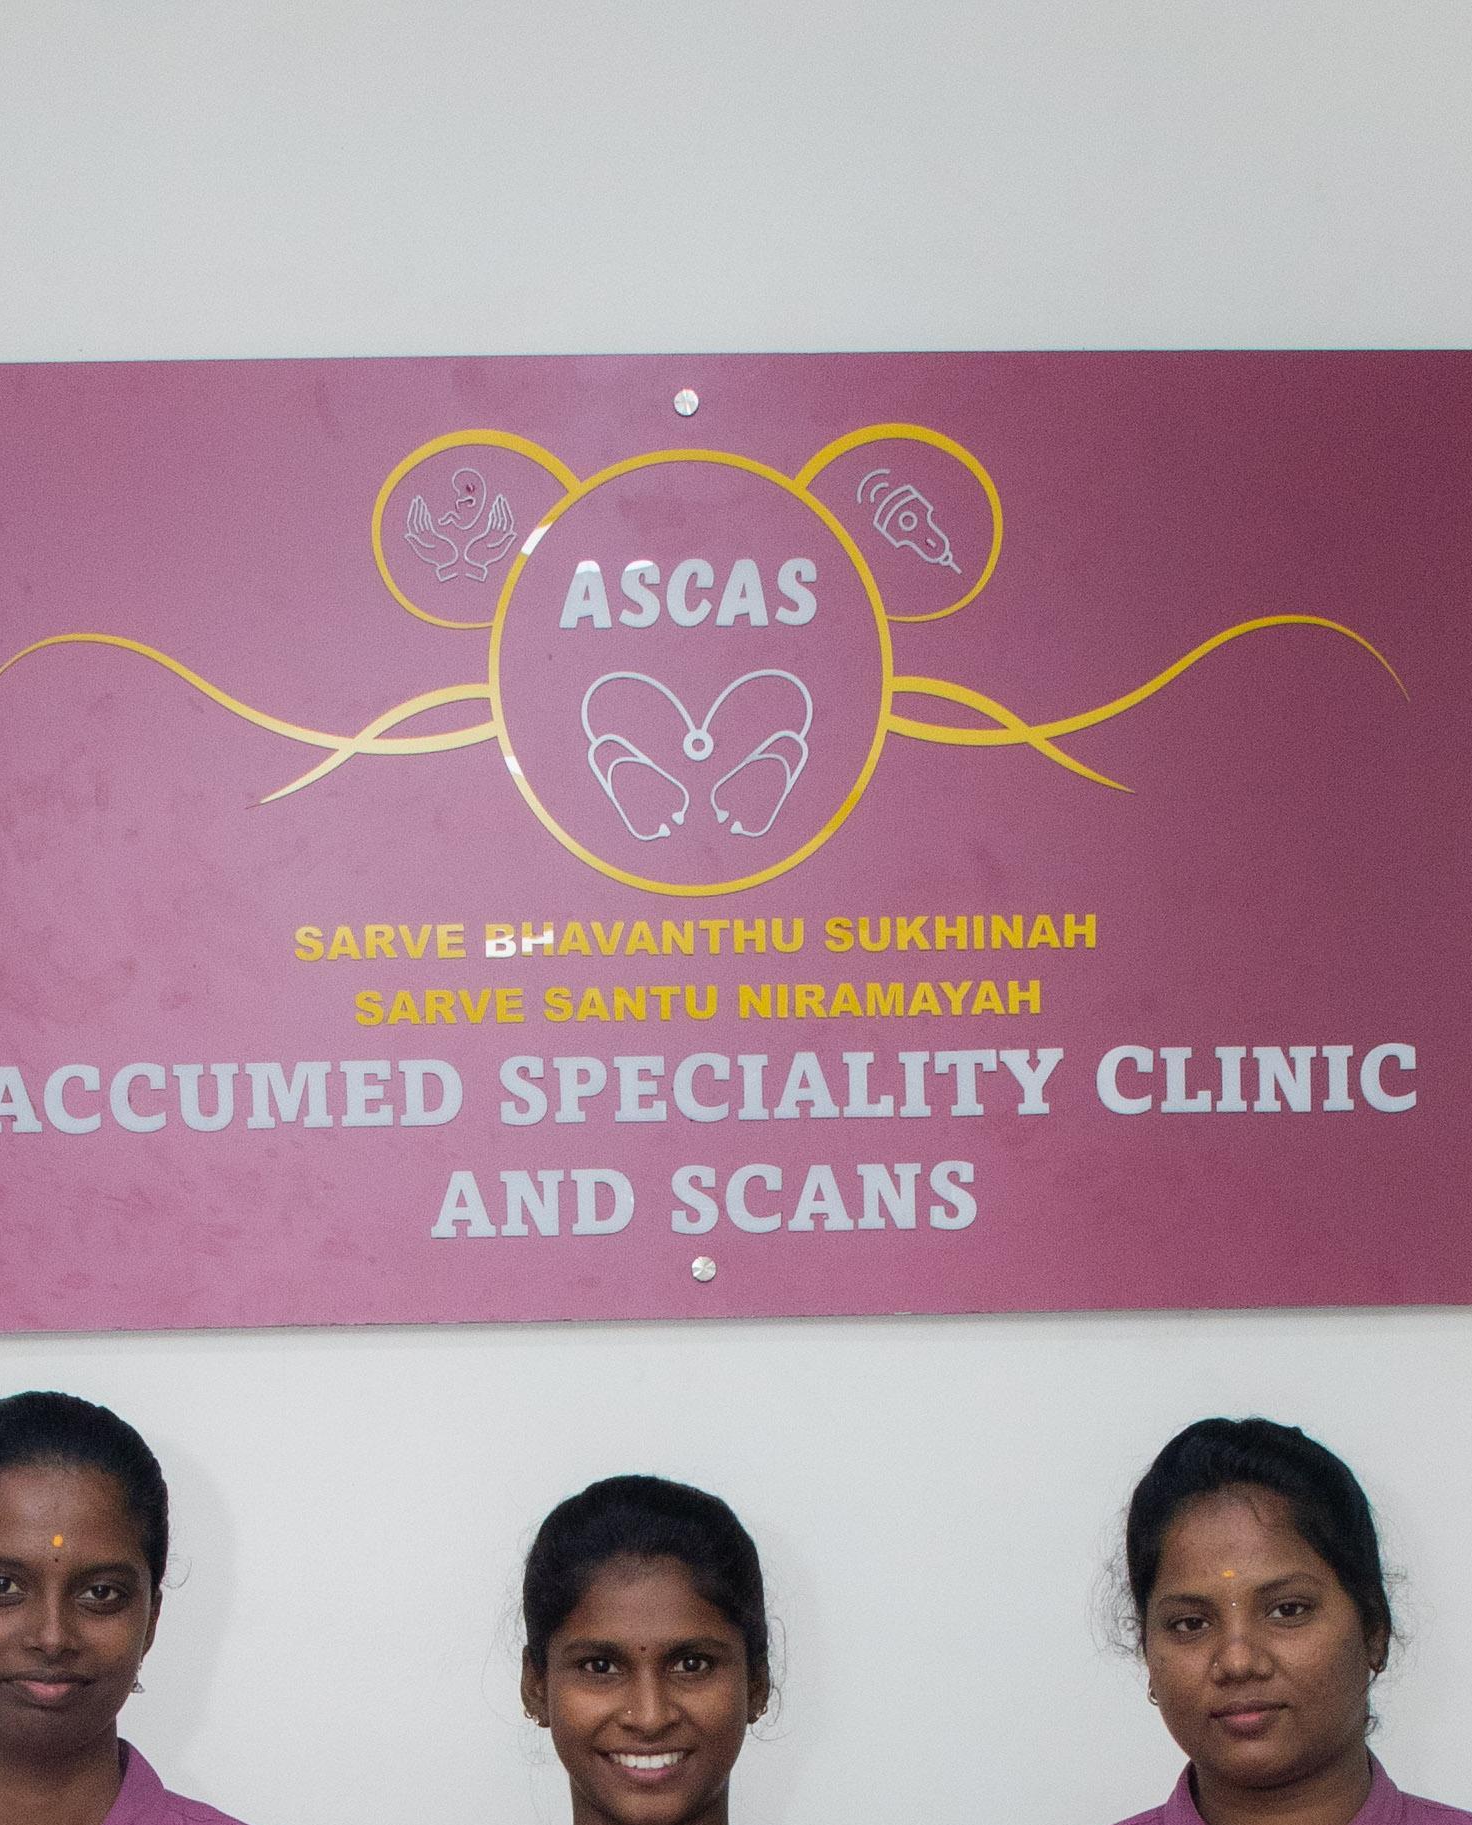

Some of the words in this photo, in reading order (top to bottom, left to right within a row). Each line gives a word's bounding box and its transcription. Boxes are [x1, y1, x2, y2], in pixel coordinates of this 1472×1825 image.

[558, 557, 818, 630] ASCAS
[295, 924, 467, 962] SARVE
[485, 918, 806, 959] BHAVANTHU
[824, 913, 1098, 953] SUKHINAH
[354, 988, 524, 1028] SARVE
[544, 983, 718, 1023] SANTU
[739, 978, 1043, 1019] NIRAMAYAH
[499, 1048, 1064, 1126] SPECIALITY
[1096, 1042, 1417, 1115] CLINIC
[429, 1168, 636, 1239] AND
[671, 1160, 978, 1235] SCANS
